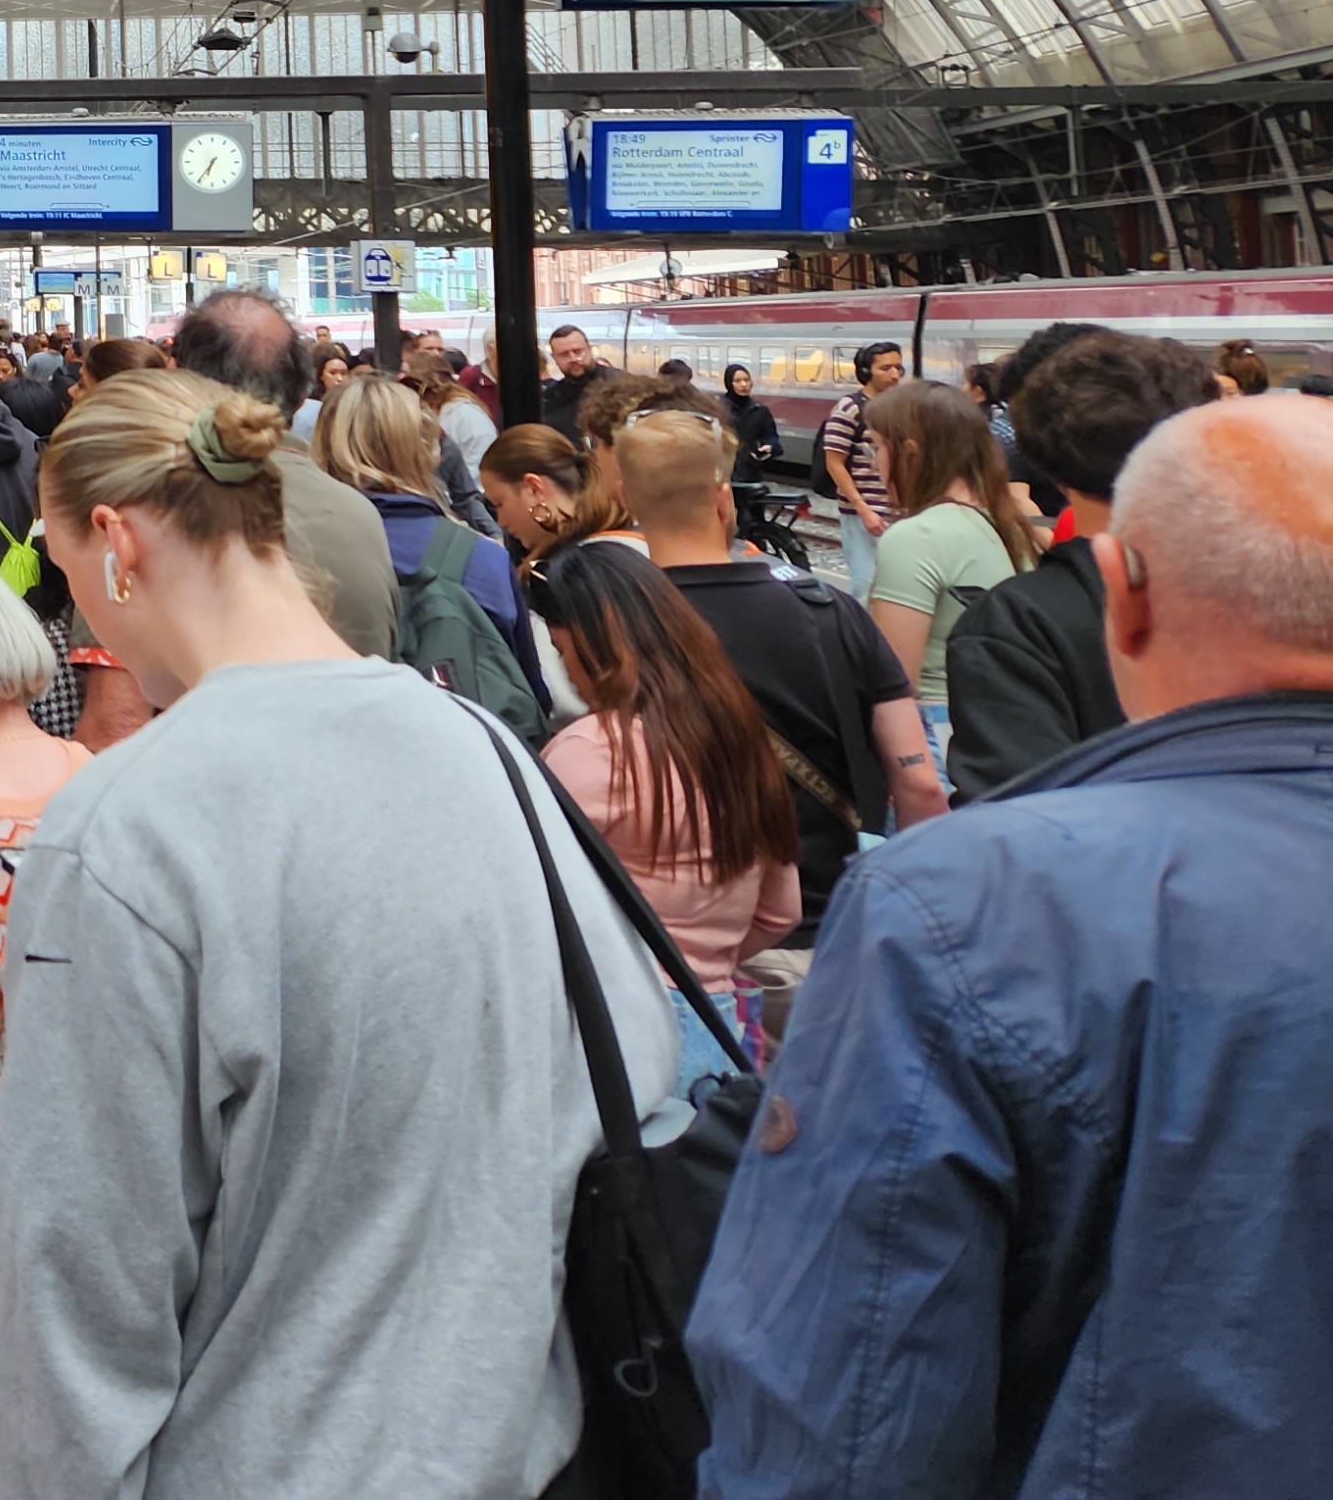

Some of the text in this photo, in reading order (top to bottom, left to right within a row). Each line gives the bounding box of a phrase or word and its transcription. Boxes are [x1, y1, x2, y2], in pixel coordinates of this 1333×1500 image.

[0, 138, 6, 147] 4
[89, 137, 127, 147] Intercity
[710, 134, 749, 144] Sprinter
[0, 149, 66, 161] Maastricht
[612, 145, 744, 158] Rotterdam Centraal
[54, 165, 79, 173] Amstel,
[110, 164, 141, 172] Centraal,
[103, 173, 134, 181] Centraal,
[0, 212, 27, 220] Volgende
[164, 262, 173, 276] L
[208, 264, 217, 278] L
[78, 284, 90, 295] M
[107, 284, 120, 295] M
